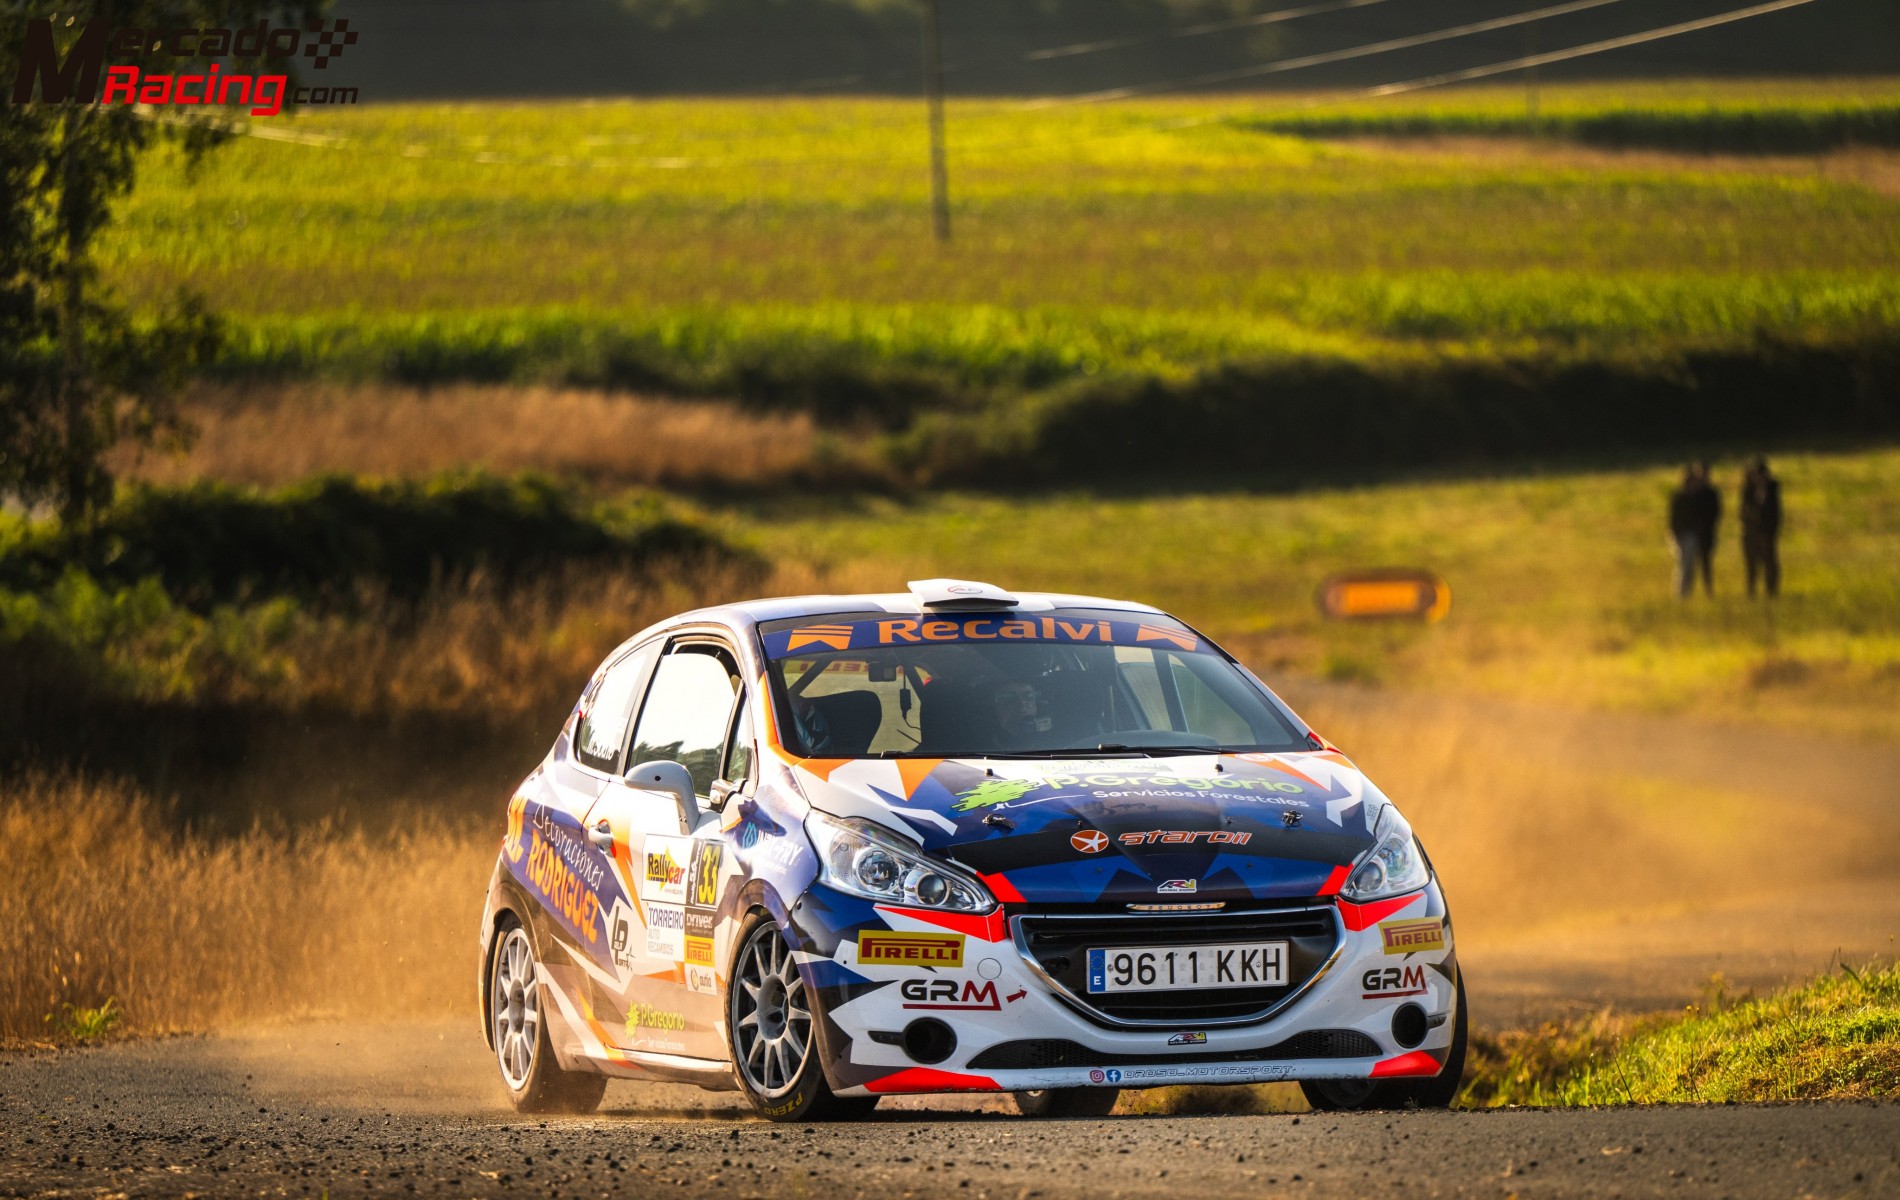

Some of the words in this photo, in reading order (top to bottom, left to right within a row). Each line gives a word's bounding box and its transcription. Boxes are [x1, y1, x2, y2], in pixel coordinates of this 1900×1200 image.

[877, 617, 1115, 644] Recalvi
[1092, 790, 1195, 800] Servicios
[1198, 790, 1311, 808] Forestales
[533, 803, 605, 891] Decoraciones
[526, 829, 599, 944] RODRIGUEZ
[699, 845, 720, 904] 33
[648, 907, 685, 930] TORREIRO
[1383, 922, 1442, 947] PIRELLI
[686, 940, 712, 962] PIRELLI
[862, 937, 961, 960] PIRELLI
[1093, 975, 1101, 986] E
[1114, 951, 1198, 986] 9611
[1217, 948, 1280, 982] KKH
[1362, 964, 1428, 996] GRM
[901, 979, 1002, 1010] GRM
